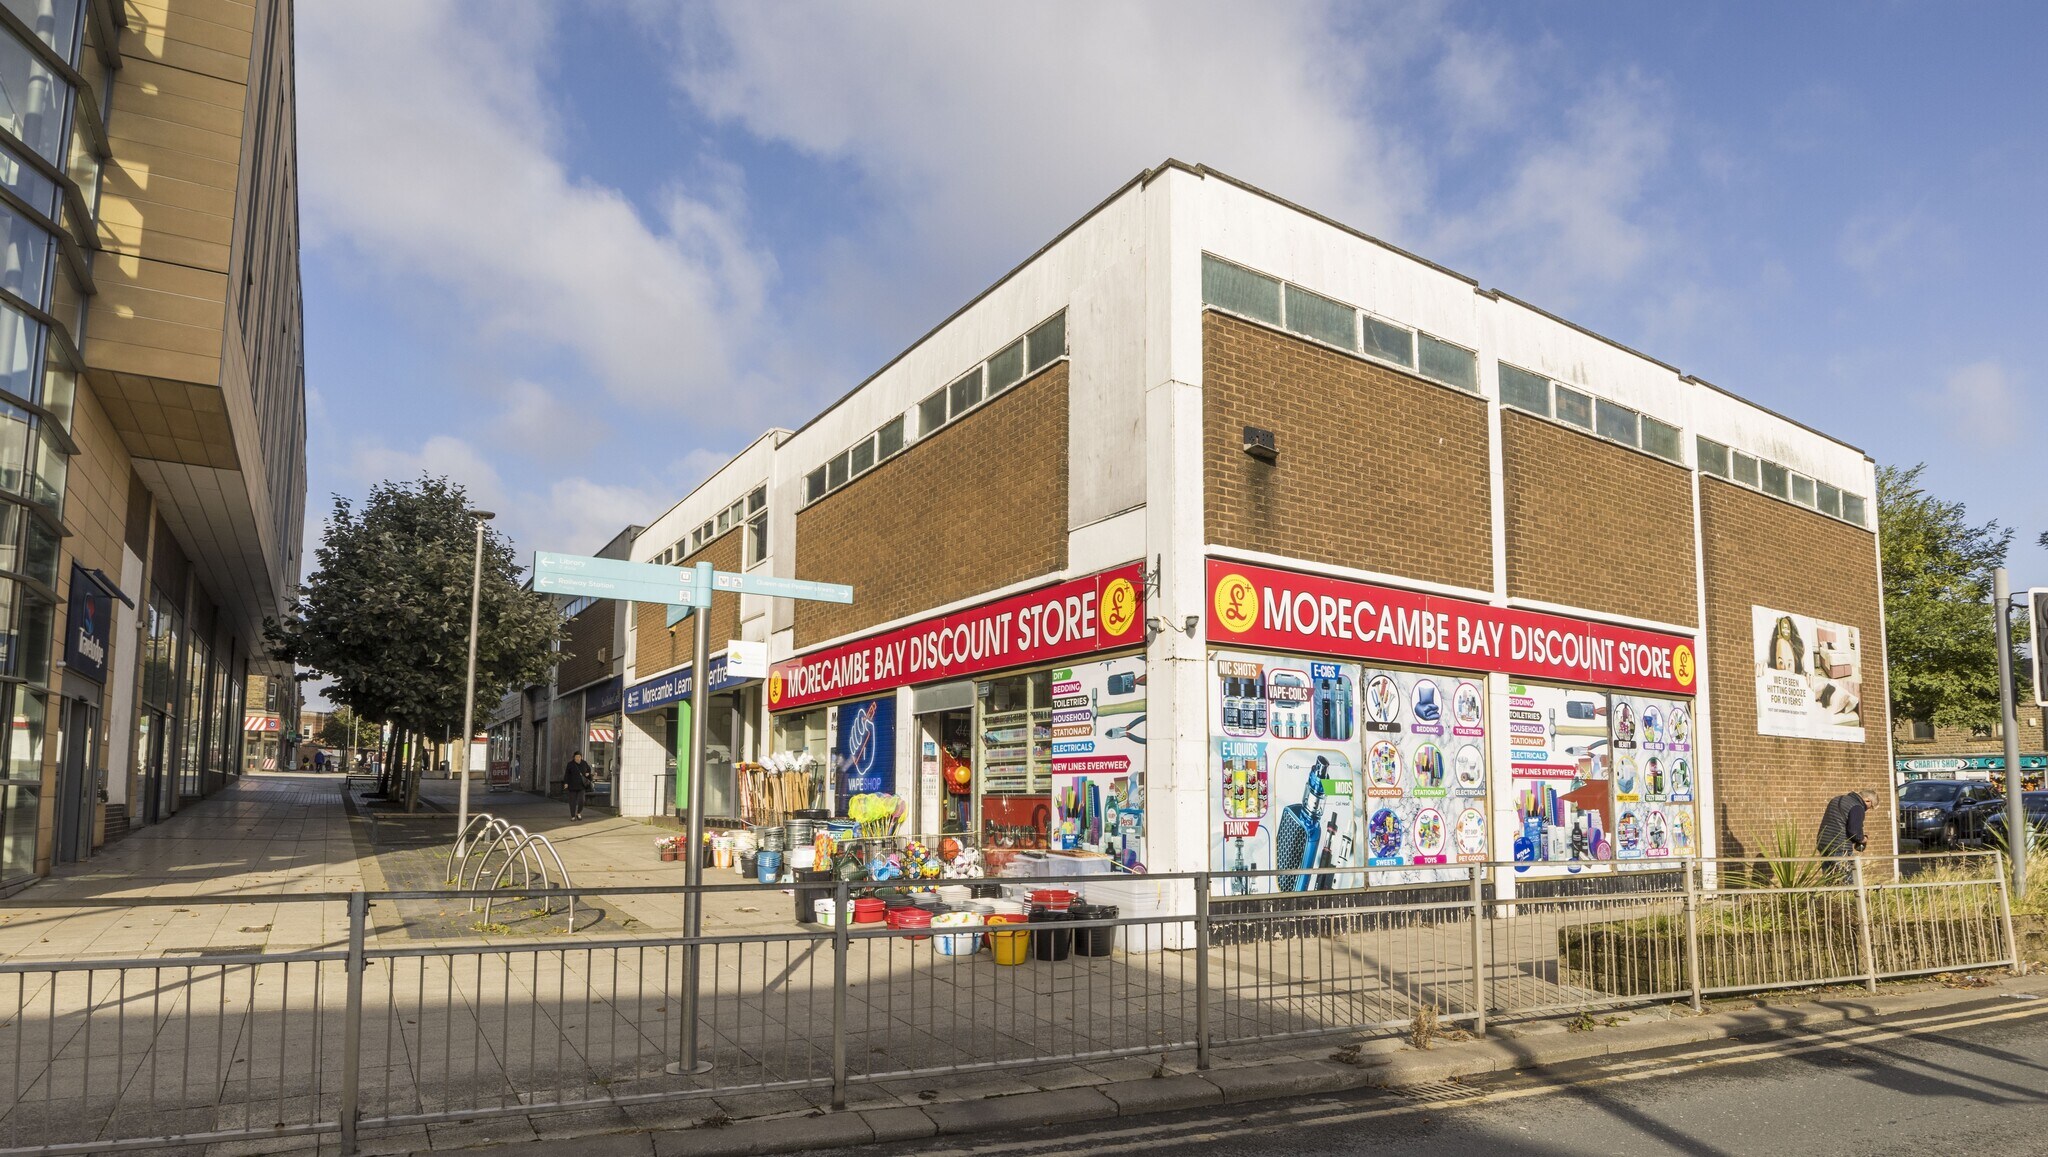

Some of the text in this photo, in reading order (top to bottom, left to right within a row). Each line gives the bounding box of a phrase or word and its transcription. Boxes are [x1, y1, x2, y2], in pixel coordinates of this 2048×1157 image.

[560, 557, 586, 567] Library
[558, 578, 587, 588] Railway
[588, 580, 614, 589] Station
[1264, 586, 1671, 679] MORECAMBE BAY DISCOUNT STORE
[79, 626, 103, 668] Travelodge
[788, 590, 1096, 698] MORECAMBE BAY DISCOUNT STORE
[1220, 661, 1256, 677] NIC SHOTS
[1314, 664, 1336, 678] E-CIGS
[1054, 672, 1063, 680] DIY
[1774, 676, 1799, 687] WE'VE BEEN
[642, 680, 672, 704] Morecambe
[709, 664, 727, 686] entre
[1054, 683, 1080, 693] BEDDING
[1269, 686, 1308, 700] VAPE-COILS
[1767, 685, 1806, 697] HITTING SNOOZE
[1054, 698, 1087, 708] TOILETRIES
[1771, 695, 1780, 704] FOR
[1782, 696, 1787, 704] 10
[1054, 712, 1090, 722] HOUSEHOLD
[1510, 711, 1540, 720] TOILETRIES
[1053, 727, 1090, 737] STATIONARY
[1511, 737, 1544, 745] STATIONARY
[1053, 743, 1092, 752] ELECTRICALS
[1223, 743, 1258, 756] E-LIQUIDS
[1053, 763, 1066, 771] NEW
[1087, 761, 1128, 770] EVERYWEEK
[1914, 760, 1958, 768] CHARITY SHOP
[1335, 781, 1352, 794] MODS
[1225, 822, 1249, 836] TANKS
